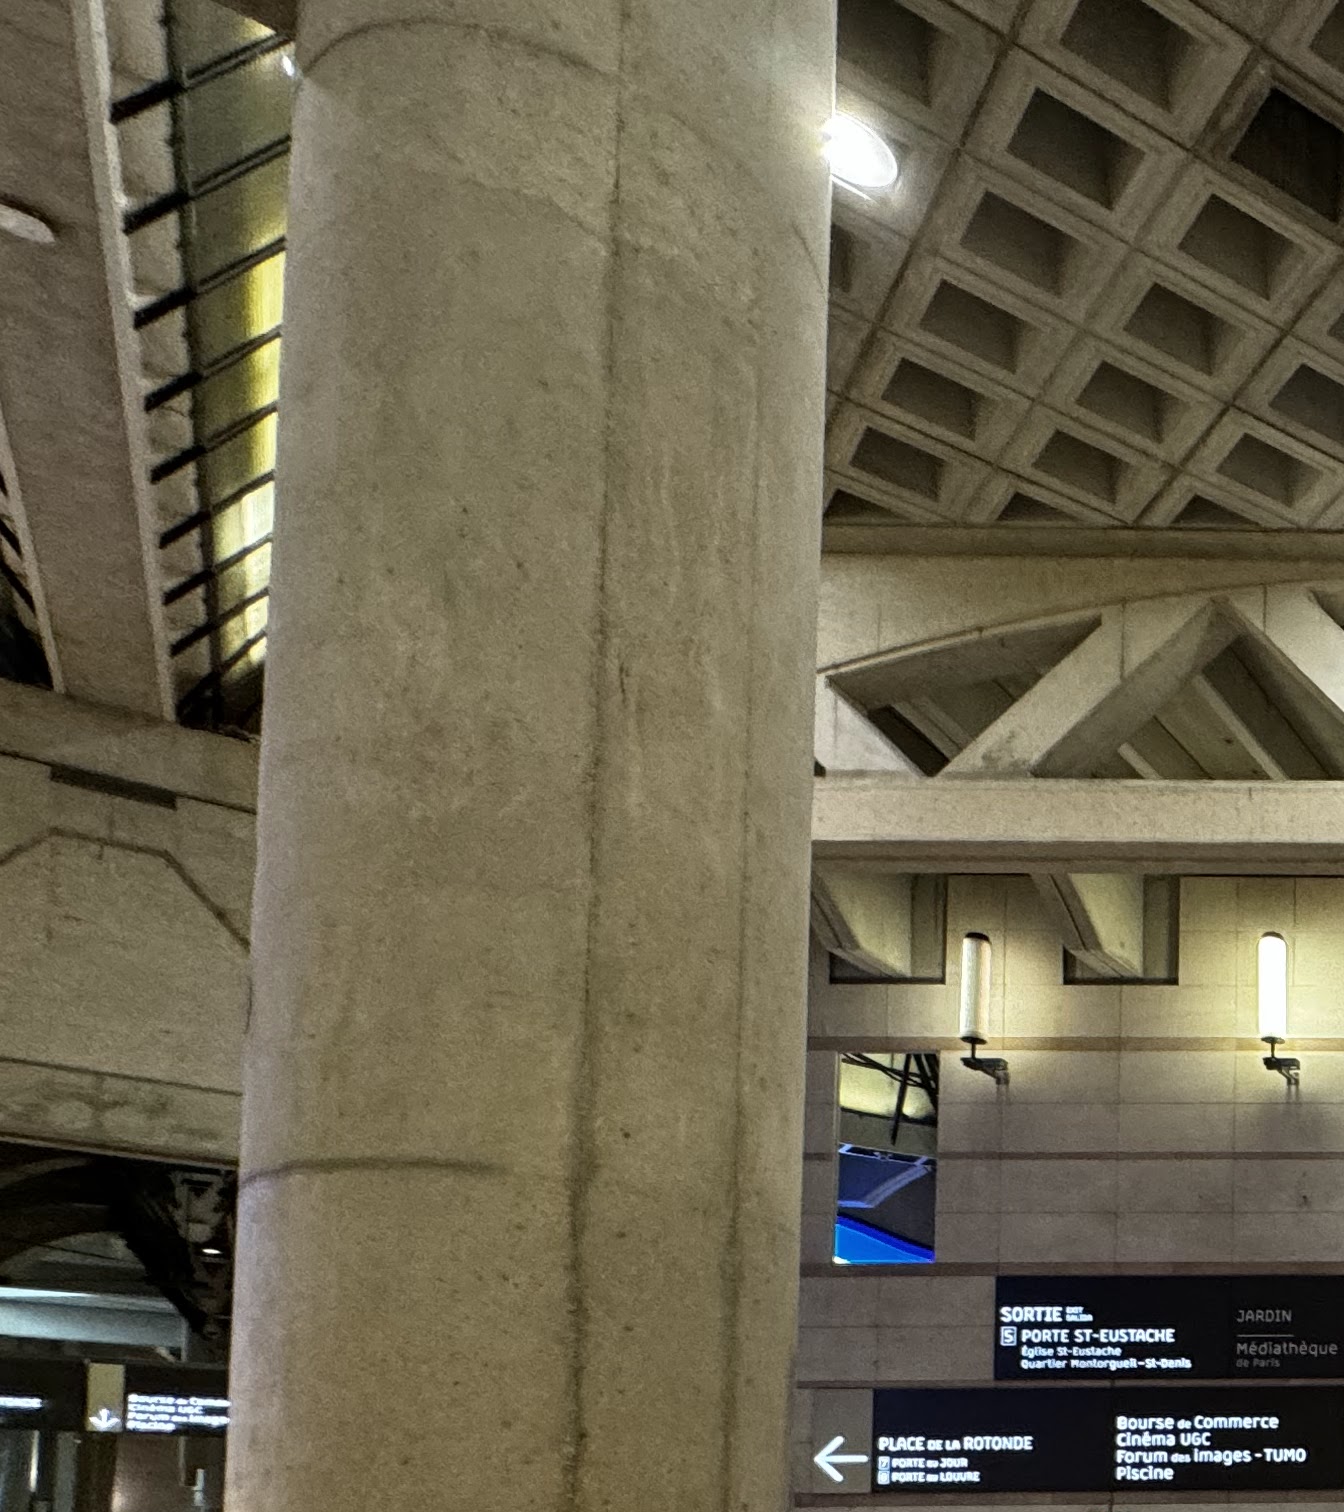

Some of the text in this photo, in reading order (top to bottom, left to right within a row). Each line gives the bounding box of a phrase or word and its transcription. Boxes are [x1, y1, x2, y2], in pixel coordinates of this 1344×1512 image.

[999, 1306, 1063, 1322] SORTIE
[1236, 1309, 1292, 1323] JARDIN
[1021, 1328, 1070, 1343] PORTE
[1073, 1328, 1176, 1343] ST-EUSTACHE
[1056, 1346, 1122, 1357] St-Eustache
[1236, 1340, 1338, 1357] Médiathèque
[1021, 1358, 1067, 1369] Quartier
[1252, 1358, 1281, 1368] Paris
[1116, 1415, 1279, 1430] Bourse de Commerce
[878, 1436, 925, 1451] PLACE
[963, 1436, 1034, 1451] ROTONDE
[1116, 1431, 1212, 1447] Cinéma UGC
[891, 1458, 925, 1468] PORTE
[939, 1458, 968, 1468] JOUR
[1116, 1450, 1168, 1463] Forum
[1171, 1452, 1191, 1463] des
[1194, 1448, 1252, 1466] images
[1263, 1448, 1307, 1463] TUMO
[1116, 1465, 1175, 1481] Piscine
